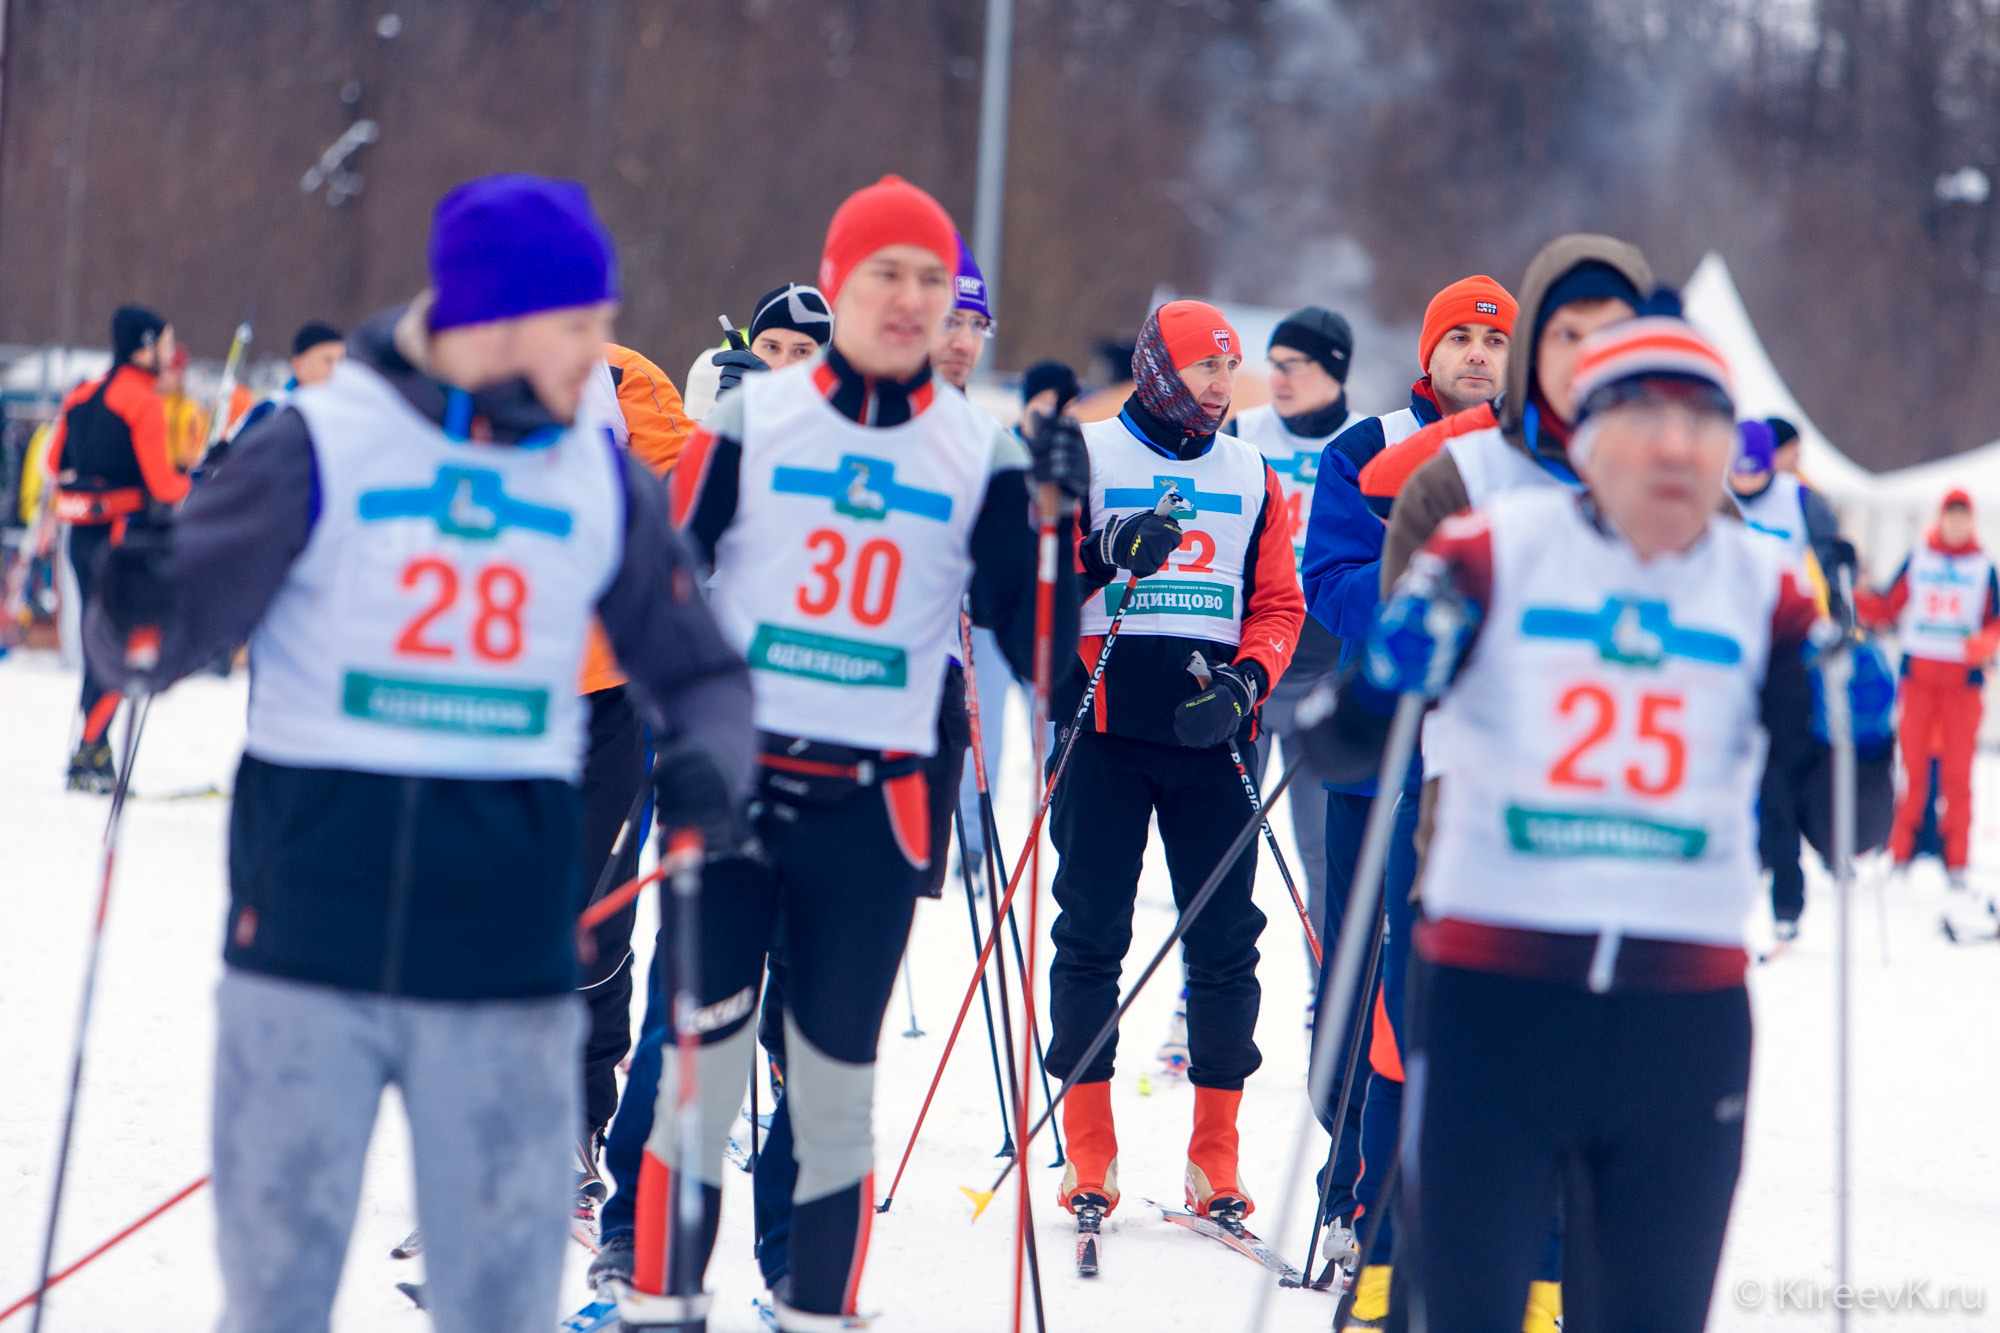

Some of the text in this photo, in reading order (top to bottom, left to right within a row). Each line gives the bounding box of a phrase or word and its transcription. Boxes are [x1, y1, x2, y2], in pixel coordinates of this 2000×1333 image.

[797, 529, 902, 627] 30
[1158, 530, 1216, 573] 2
[395, 558, 527, 663] 28
[1550, 685, 1685, 796] 25
